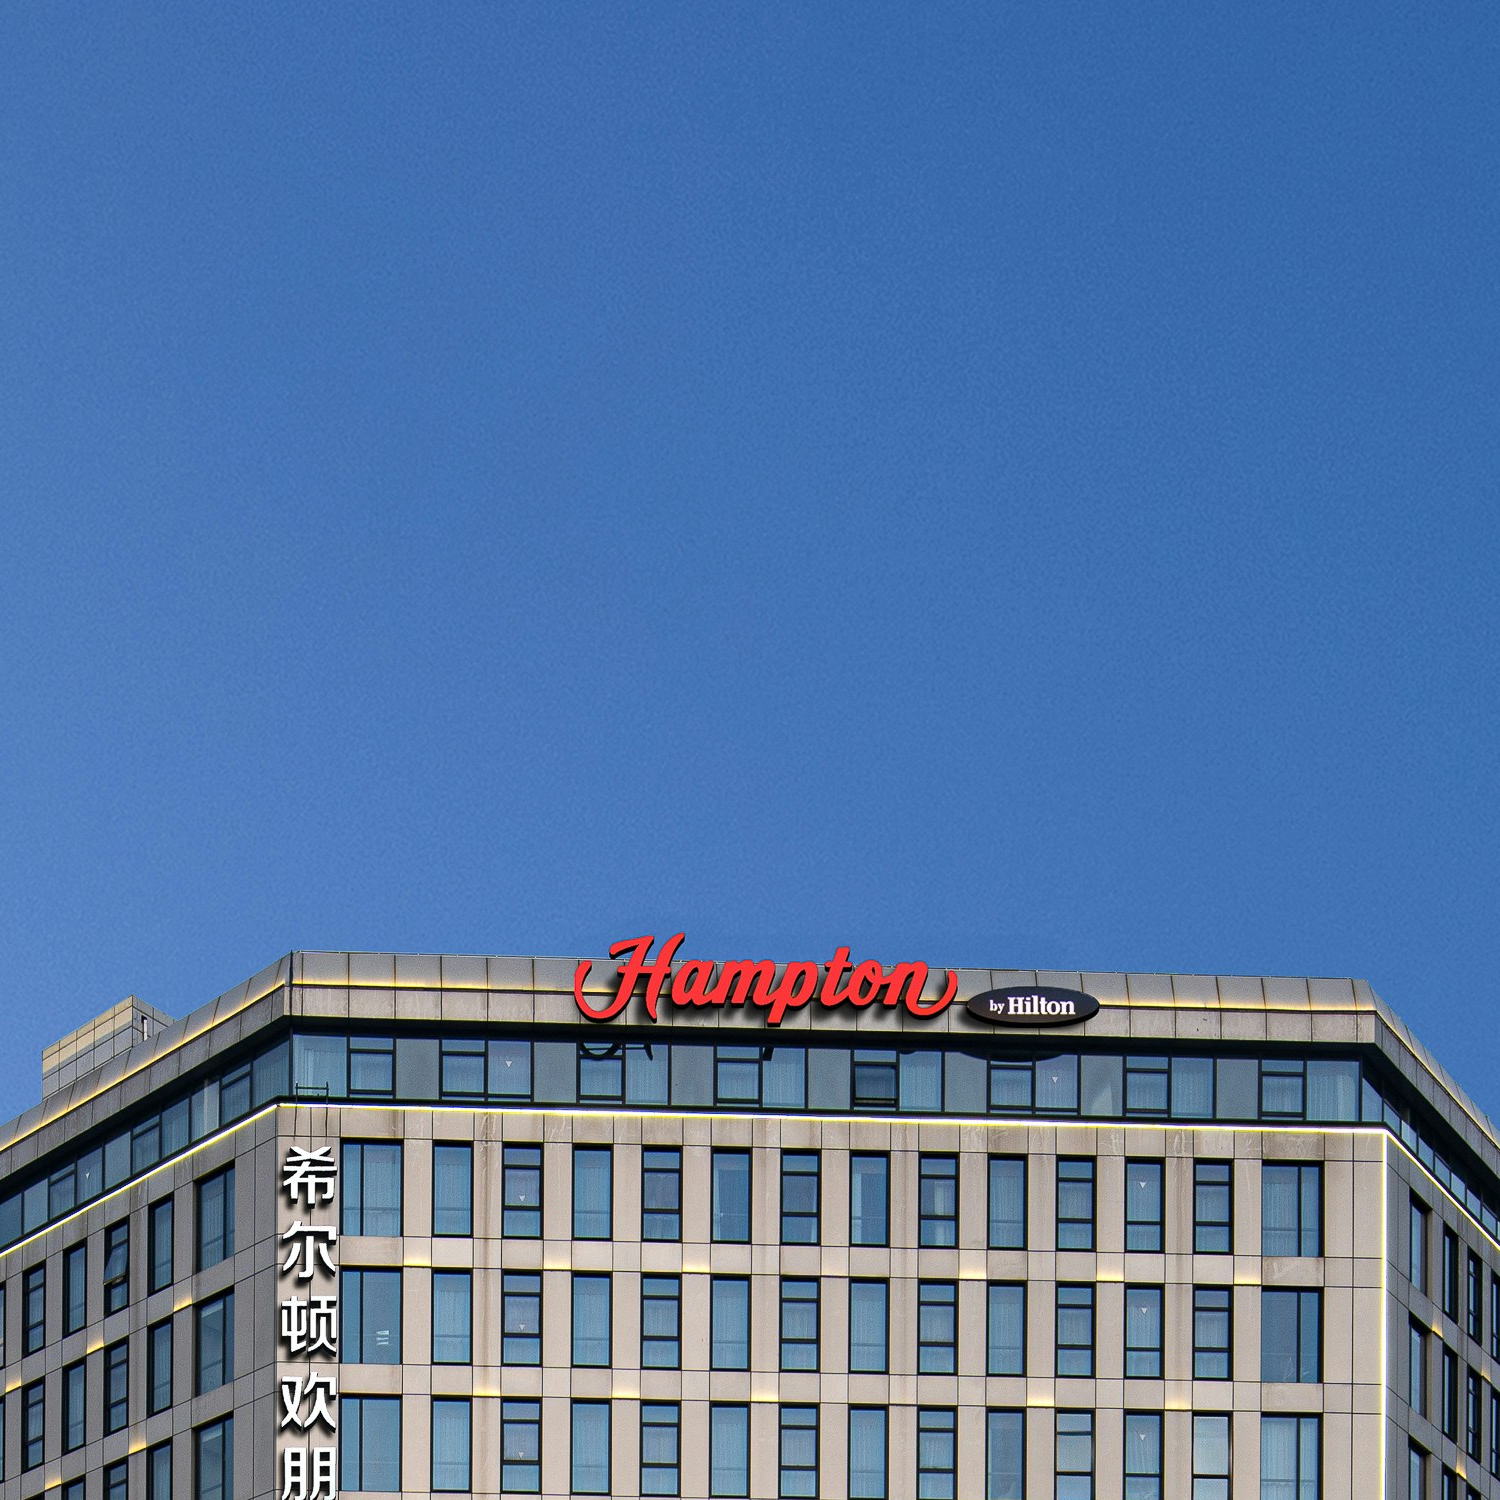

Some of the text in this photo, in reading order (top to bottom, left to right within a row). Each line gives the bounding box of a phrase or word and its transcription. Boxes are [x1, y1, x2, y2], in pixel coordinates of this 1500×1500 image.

[573, 932, 959, 1028] Hampton
[988, 994, 1076, 1017] by Hilton
